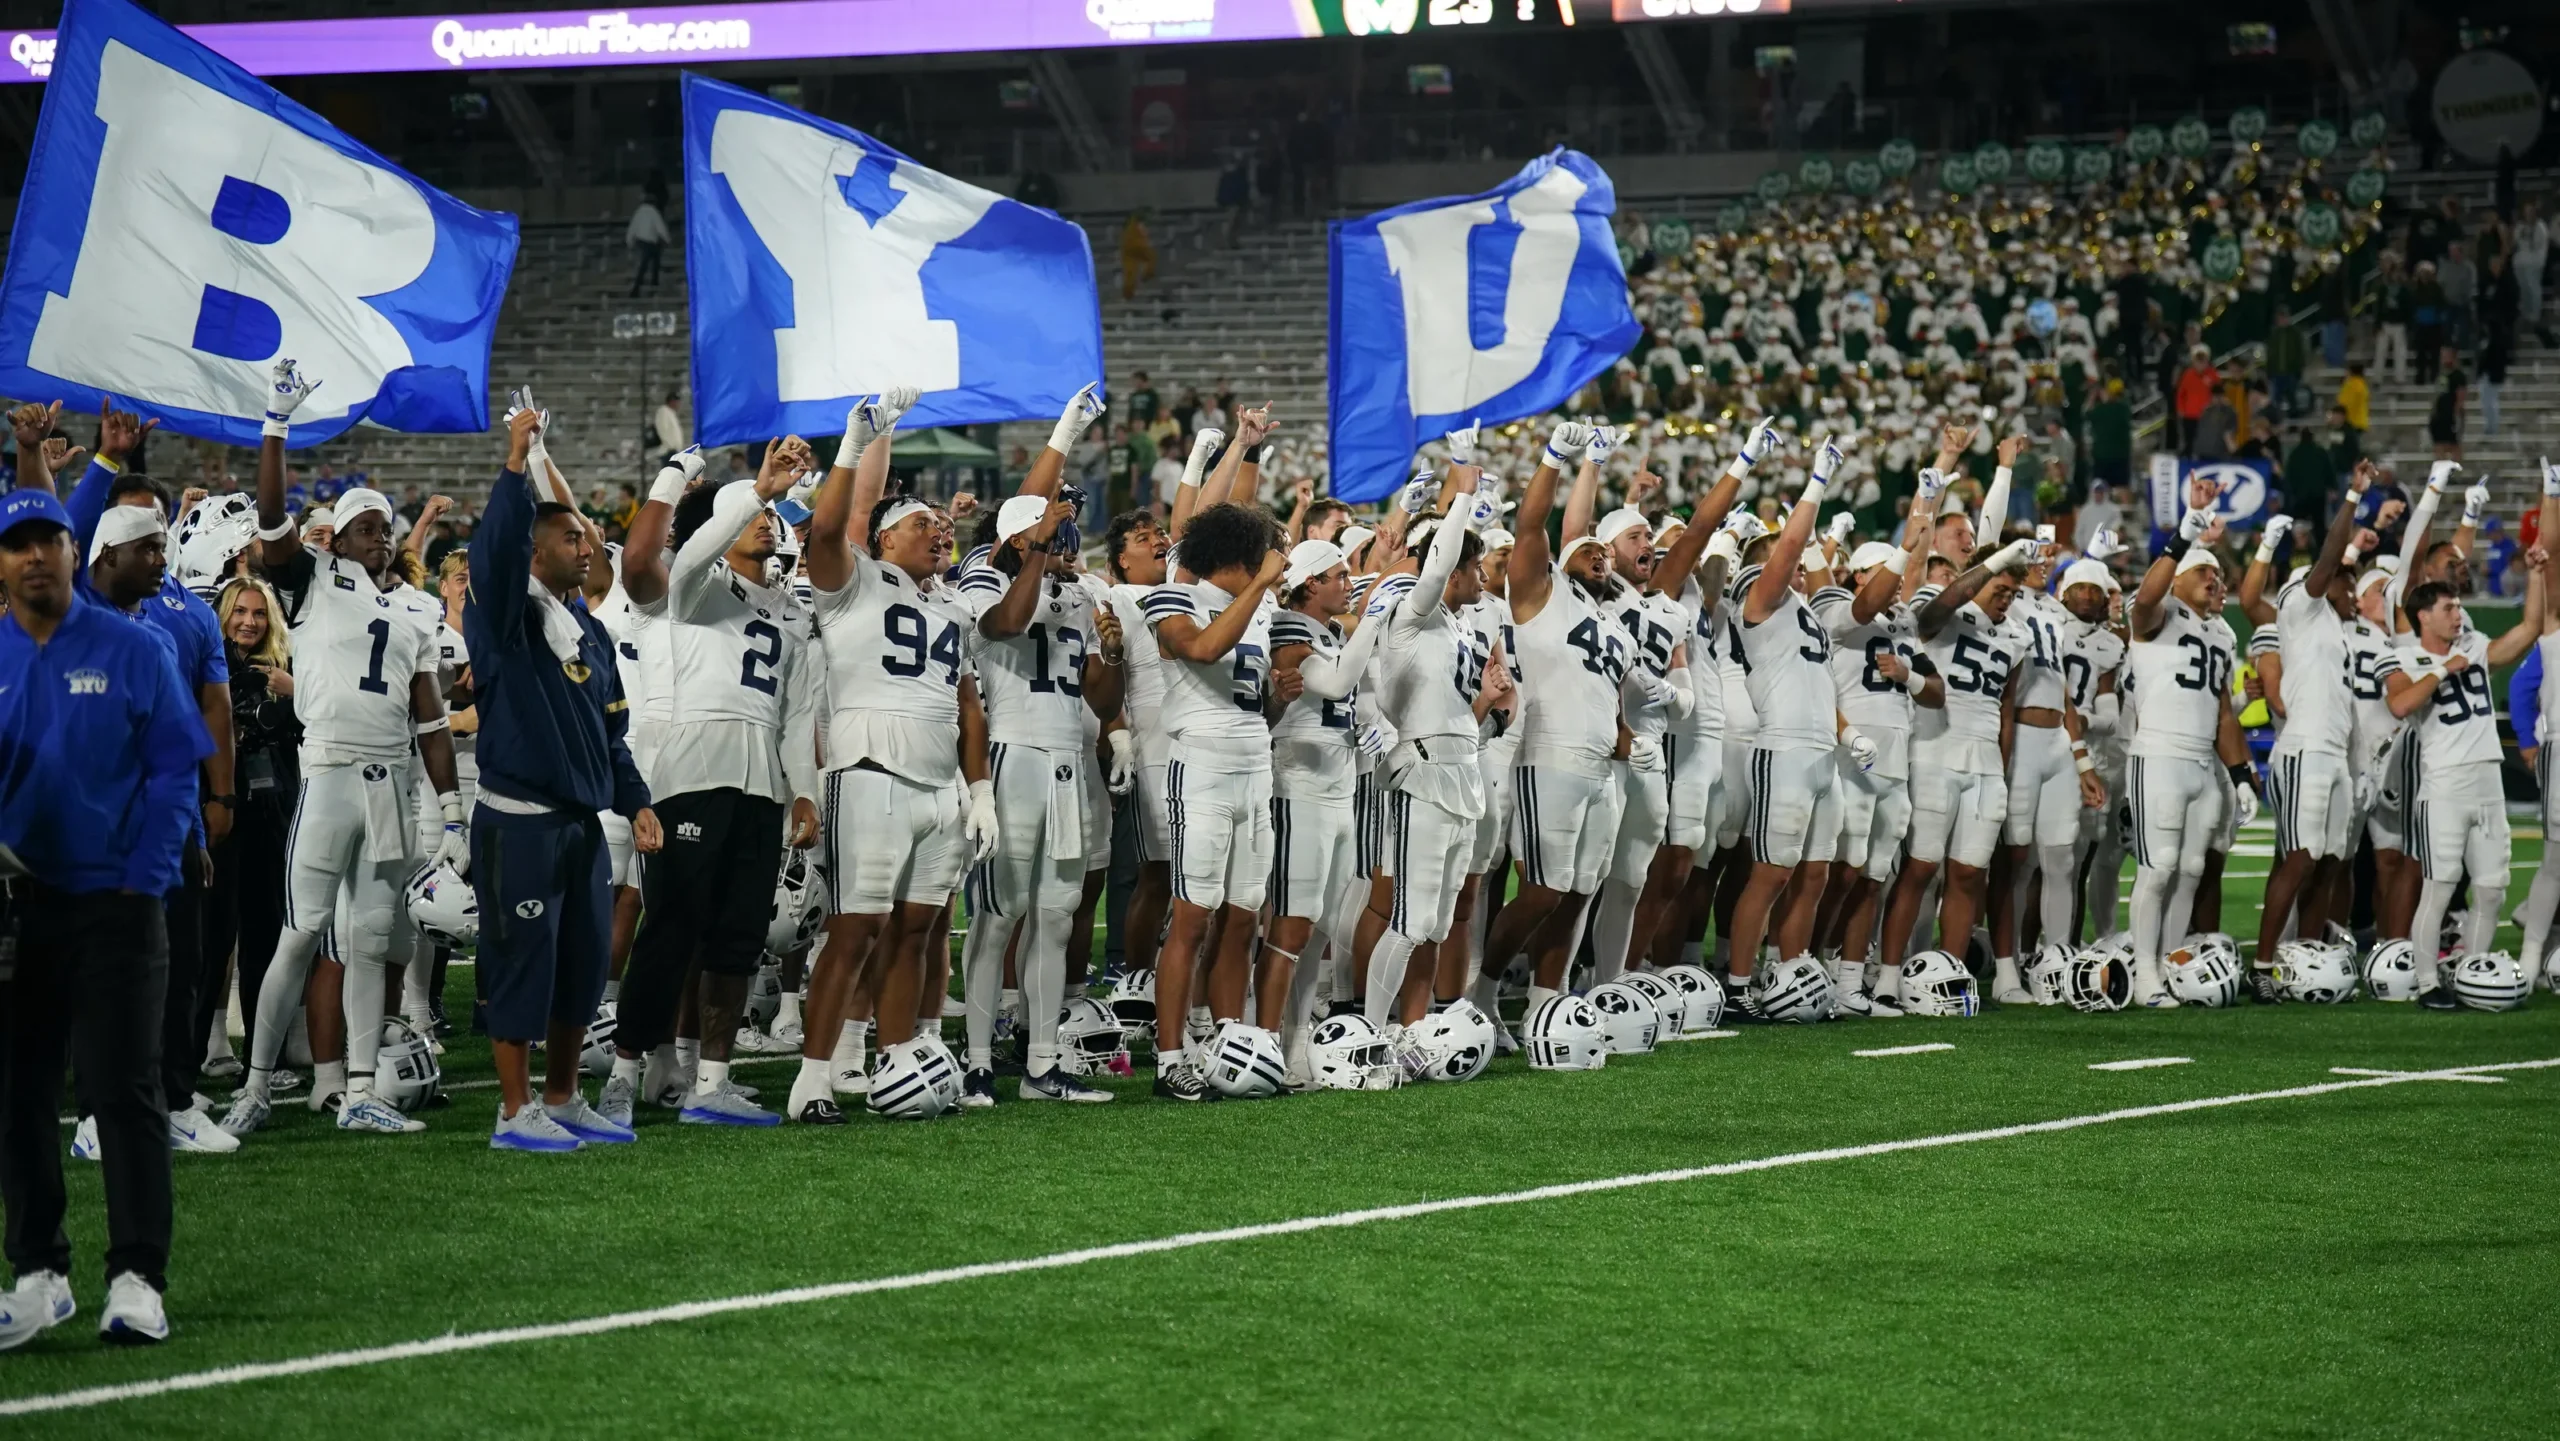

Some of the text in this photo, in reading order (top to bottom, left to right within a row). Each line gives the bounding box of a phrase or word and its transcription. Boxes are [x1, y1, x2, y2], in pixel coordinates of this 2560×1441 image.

[432, 12, 750, 65] QuantumFiber.com
[26, 37, 1587, 425] B Y U
[7, 498, 46, 515] BYU
[329, 557, 340, 574] A
[359, 617, 390, 696] 1
[740, 619, 783, 698] 2
[882, 603, 961, 687] 94
[1028, 622, 1085, 698] 13
[1948, 634, 2012, 699] 52
[2026, 616, 2062, 674] 11
[2175, 633, 2229, 700] 30
[69, 678, 108, 694] BYU
[1233, 643, 1264, 713] 5
[2431, 663, 2492, 726] 99
[676, 822, 702, 837] BYU
[676, 835, 701, 843] FOOTBALL
